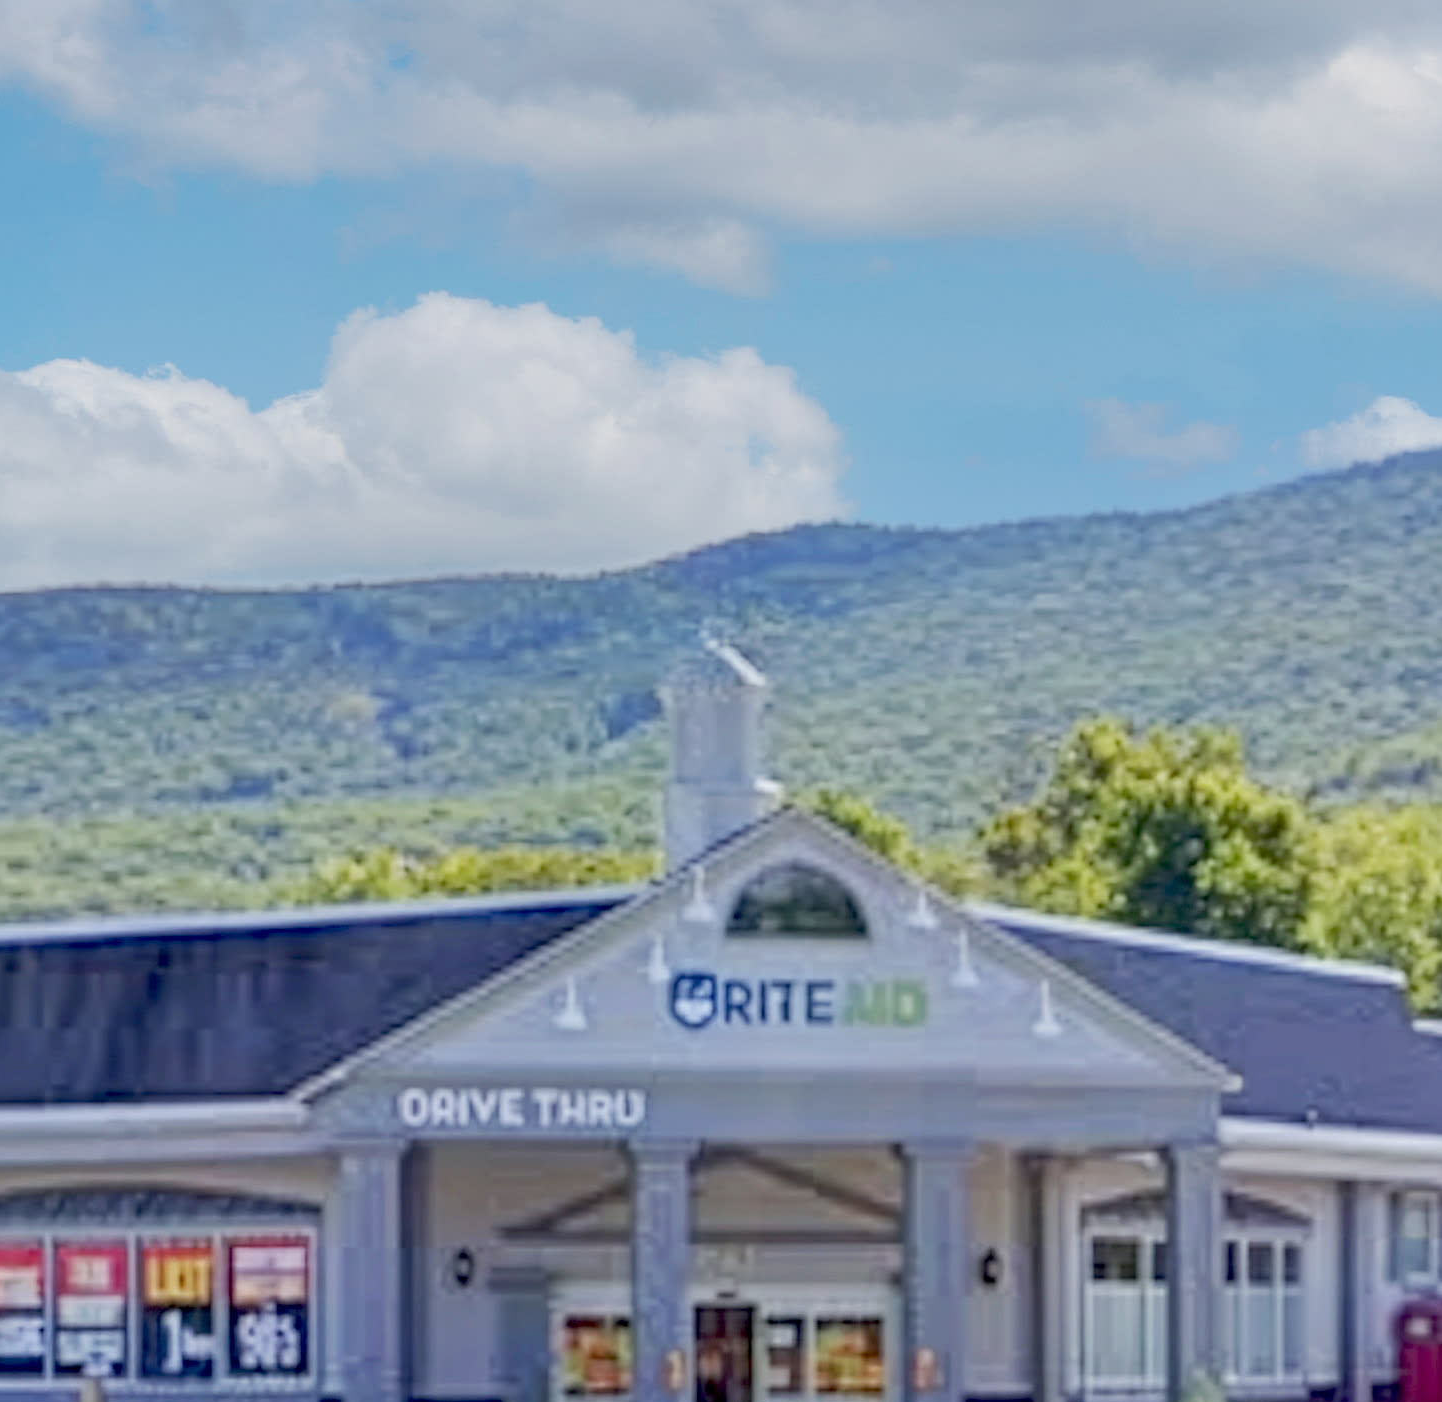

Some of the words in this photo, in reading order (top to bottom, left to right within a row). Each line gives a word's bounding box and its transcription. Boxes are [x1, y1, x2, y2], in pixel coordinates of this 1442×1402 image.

[723, 980, 836, 1025] RITE
[841, 978, 928, 1026] AID
[397, 1087, 525, 1128] DRIVE
[532, 1086, 647, 1127] THRU
